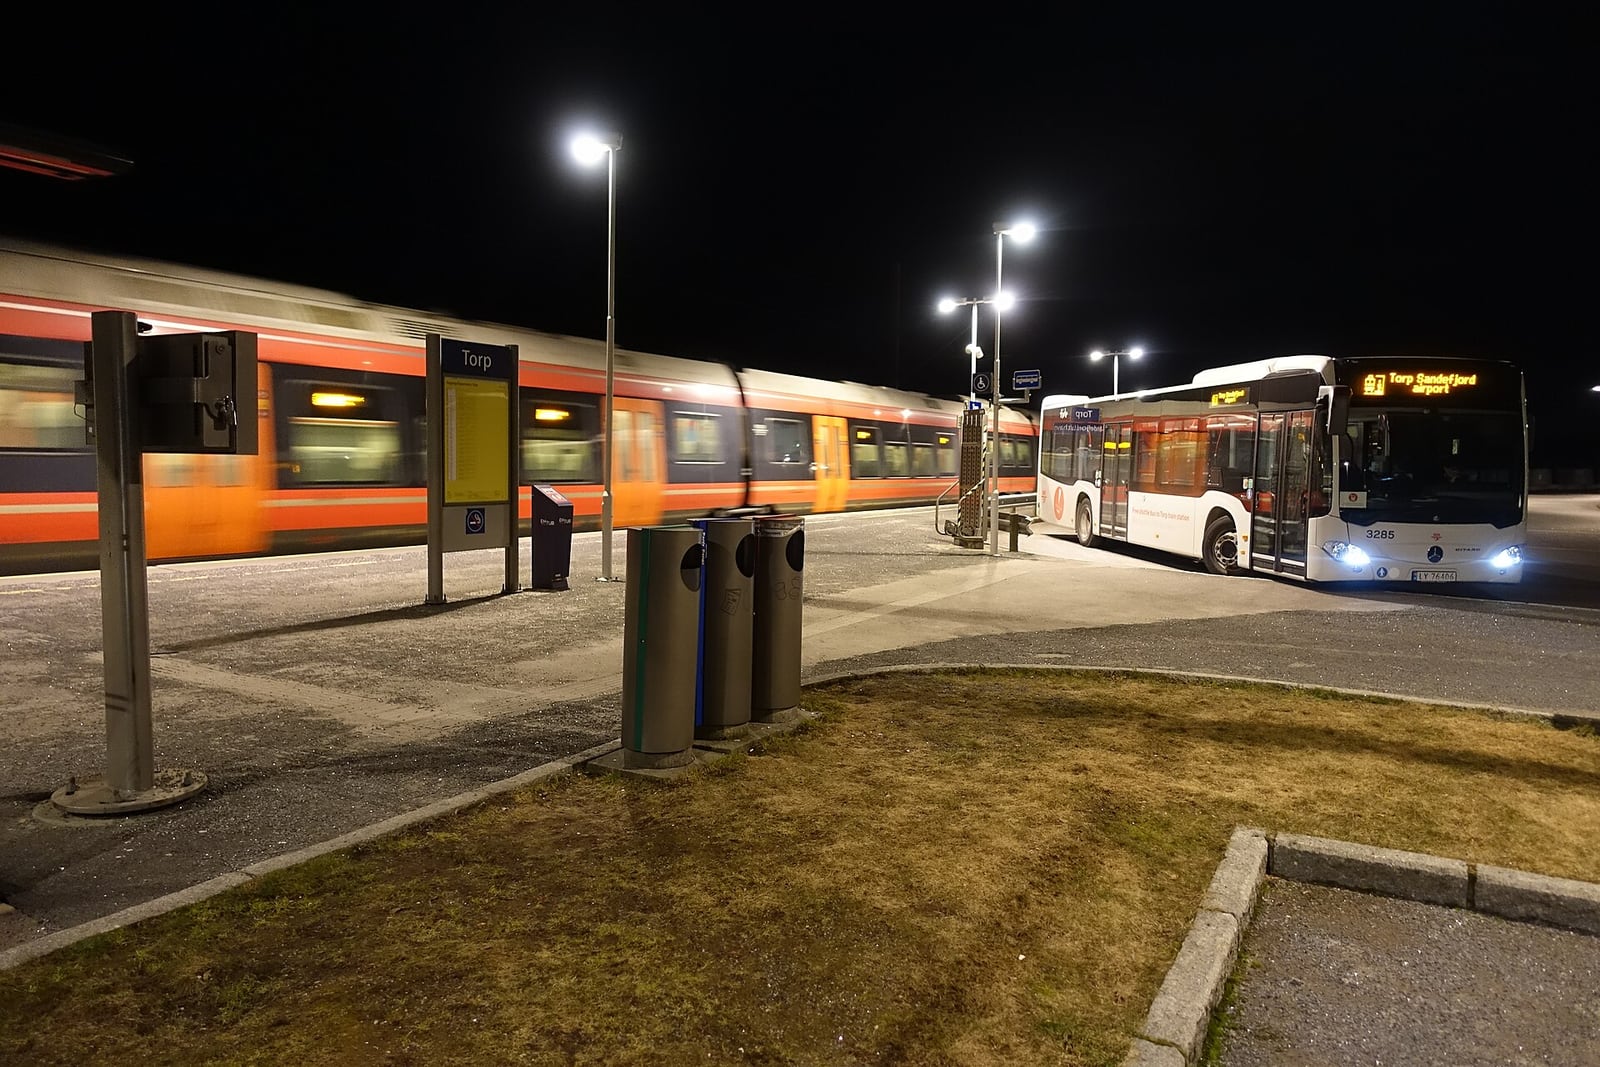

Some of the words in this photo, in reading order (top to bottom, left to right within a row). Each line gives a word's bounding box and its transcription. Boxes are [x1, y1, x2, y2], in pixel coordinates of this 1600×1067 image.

[461, 349, 492, 372] Torp
[1389, 372, 1414, 385] Torp
[1416, 373, 1477, 387] Sandefjord
[1412, 384, 1449, 396] airport
[1366, 530, 1395, 539] 3285
